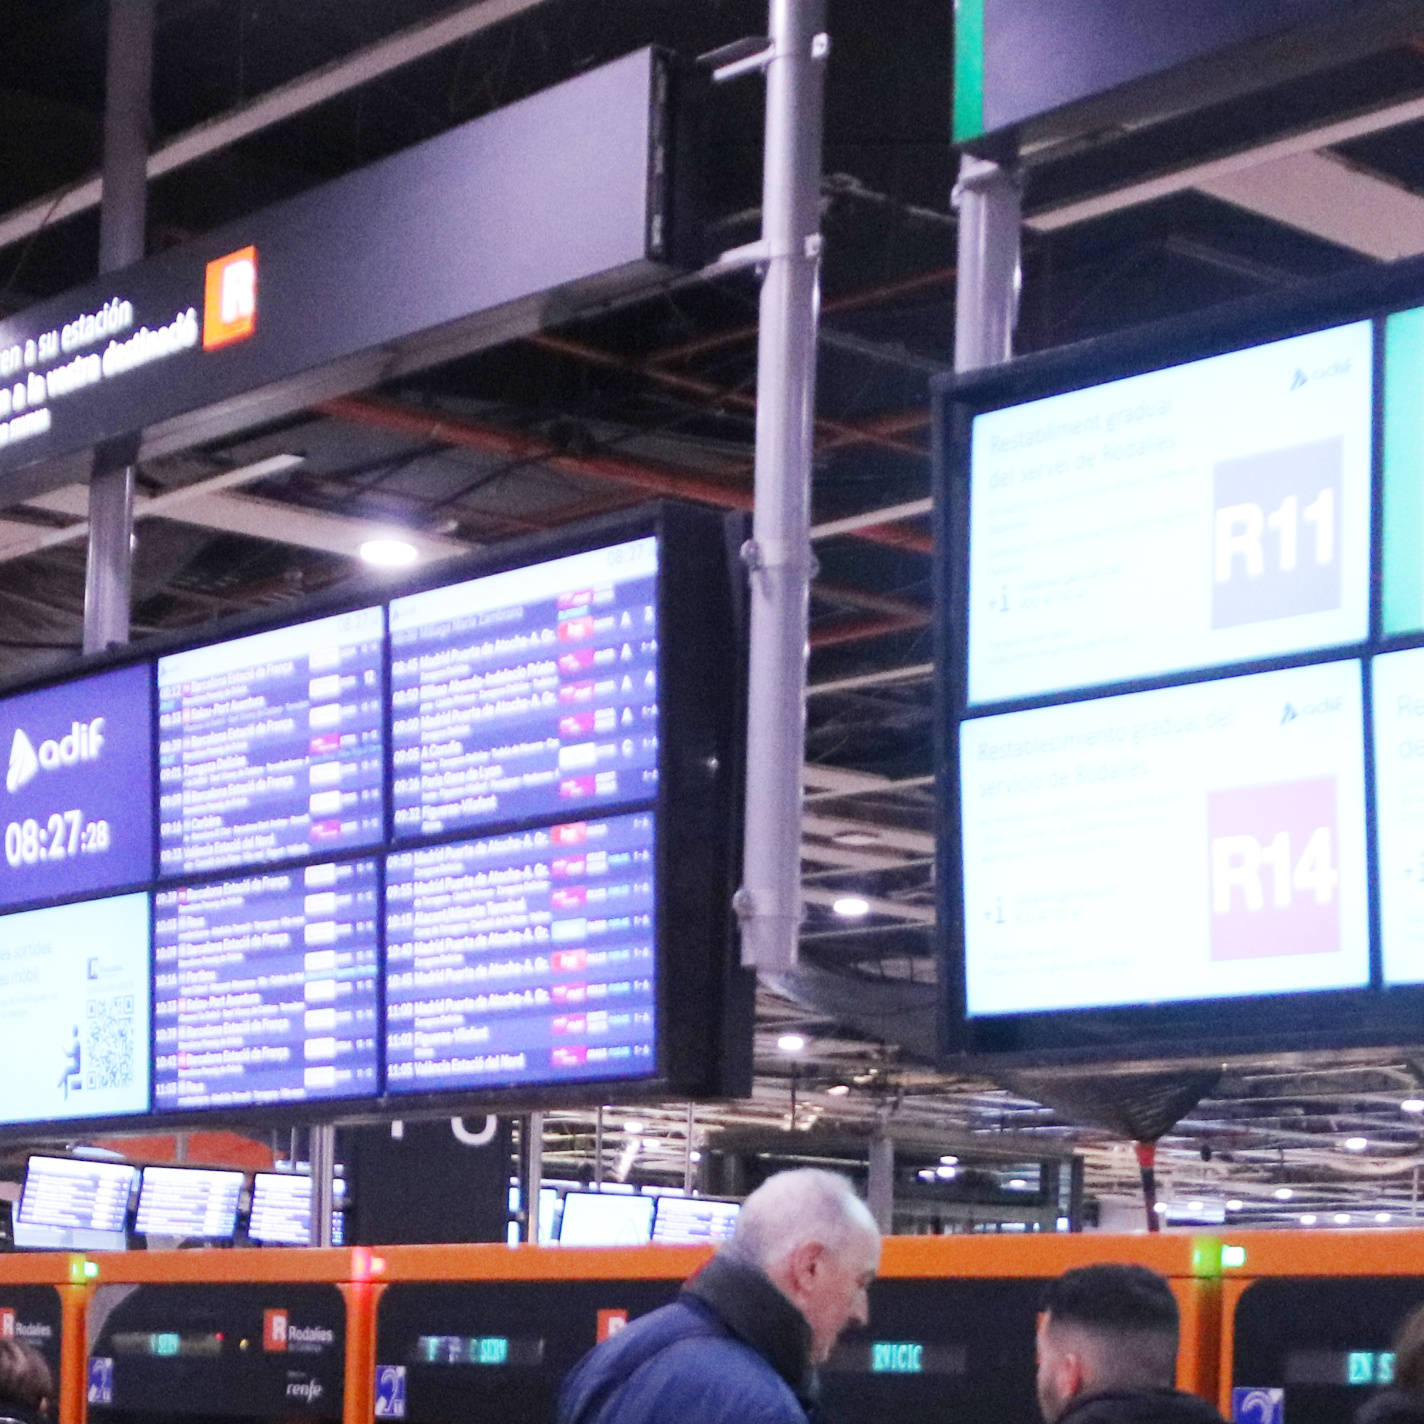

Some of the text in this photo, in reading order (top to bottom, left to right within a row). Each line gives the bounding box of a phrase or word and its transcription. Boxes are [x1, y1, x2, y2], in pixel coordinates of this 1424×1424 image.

[25, 339, 37, 367] a
[38, 330, 59, 363] su
[61, 297, 133, 352] estación
[990, 392, 1173, 454] Restabliment gradual
[1215, 487, 1335, 585] R11
[38, 717, 109, 772] adif
[978, 724, 1126, 763] Restablecimiento
[1131, 710, 1199, 746] gradual
[4, 810, 110, 867] 08:27:28
[1211, 825, 1338, 915] R14
[288, 1325, 334, 1344] Rodalies
[286, 1377, 323, 1404] renfe
